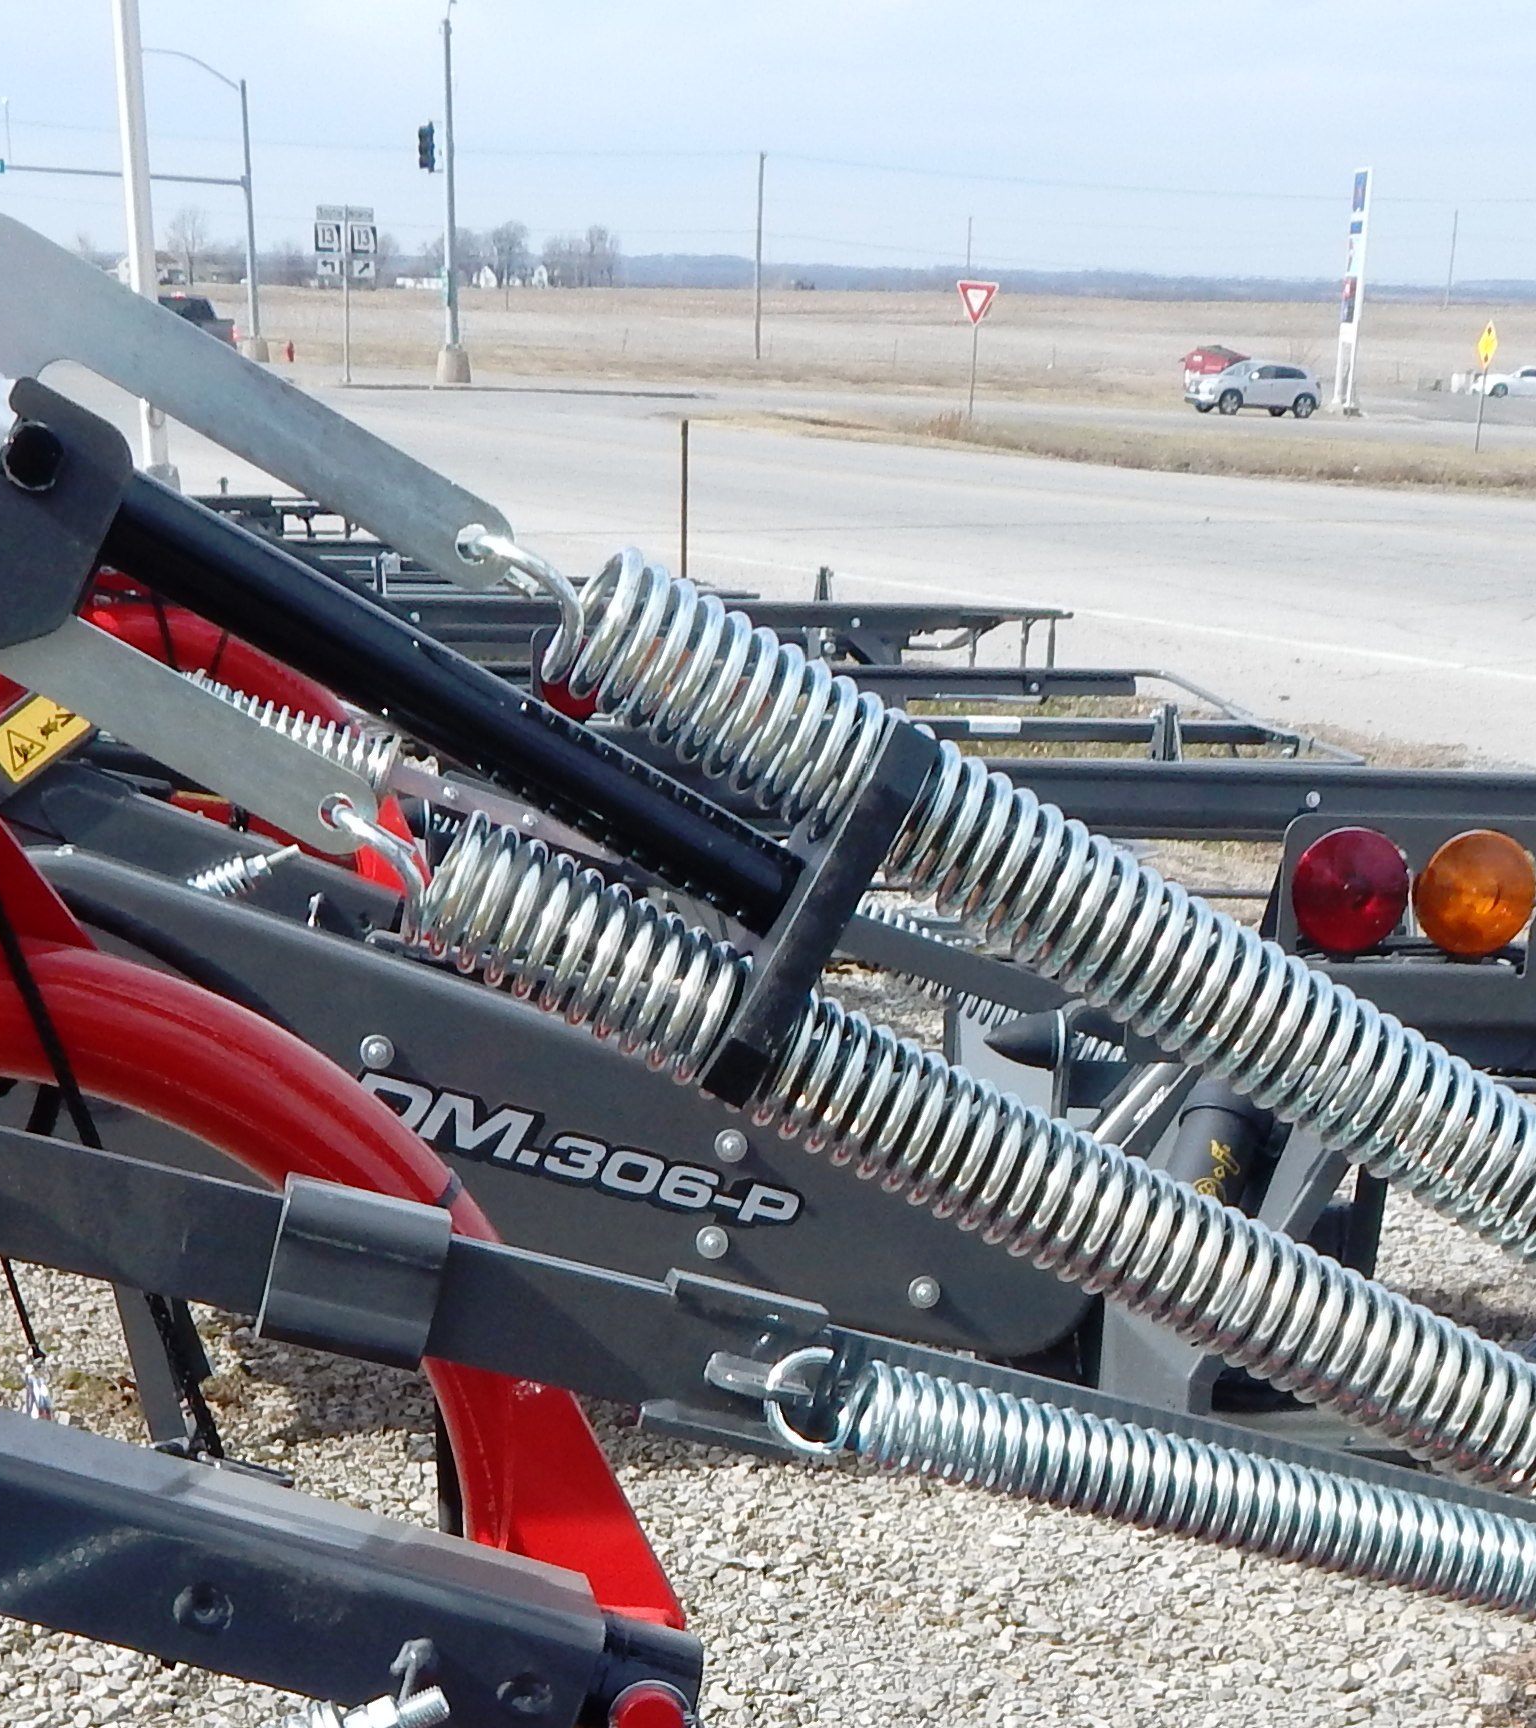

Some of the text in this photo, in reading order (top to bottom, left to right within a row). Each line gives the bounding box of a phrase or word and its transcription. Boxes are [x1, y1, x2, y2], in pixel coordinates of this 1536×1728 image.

[322, 228, 334, 244] 13
[357, 229, 370, 246] 13
[363, 1073, 799, 1222] DM.306-P
